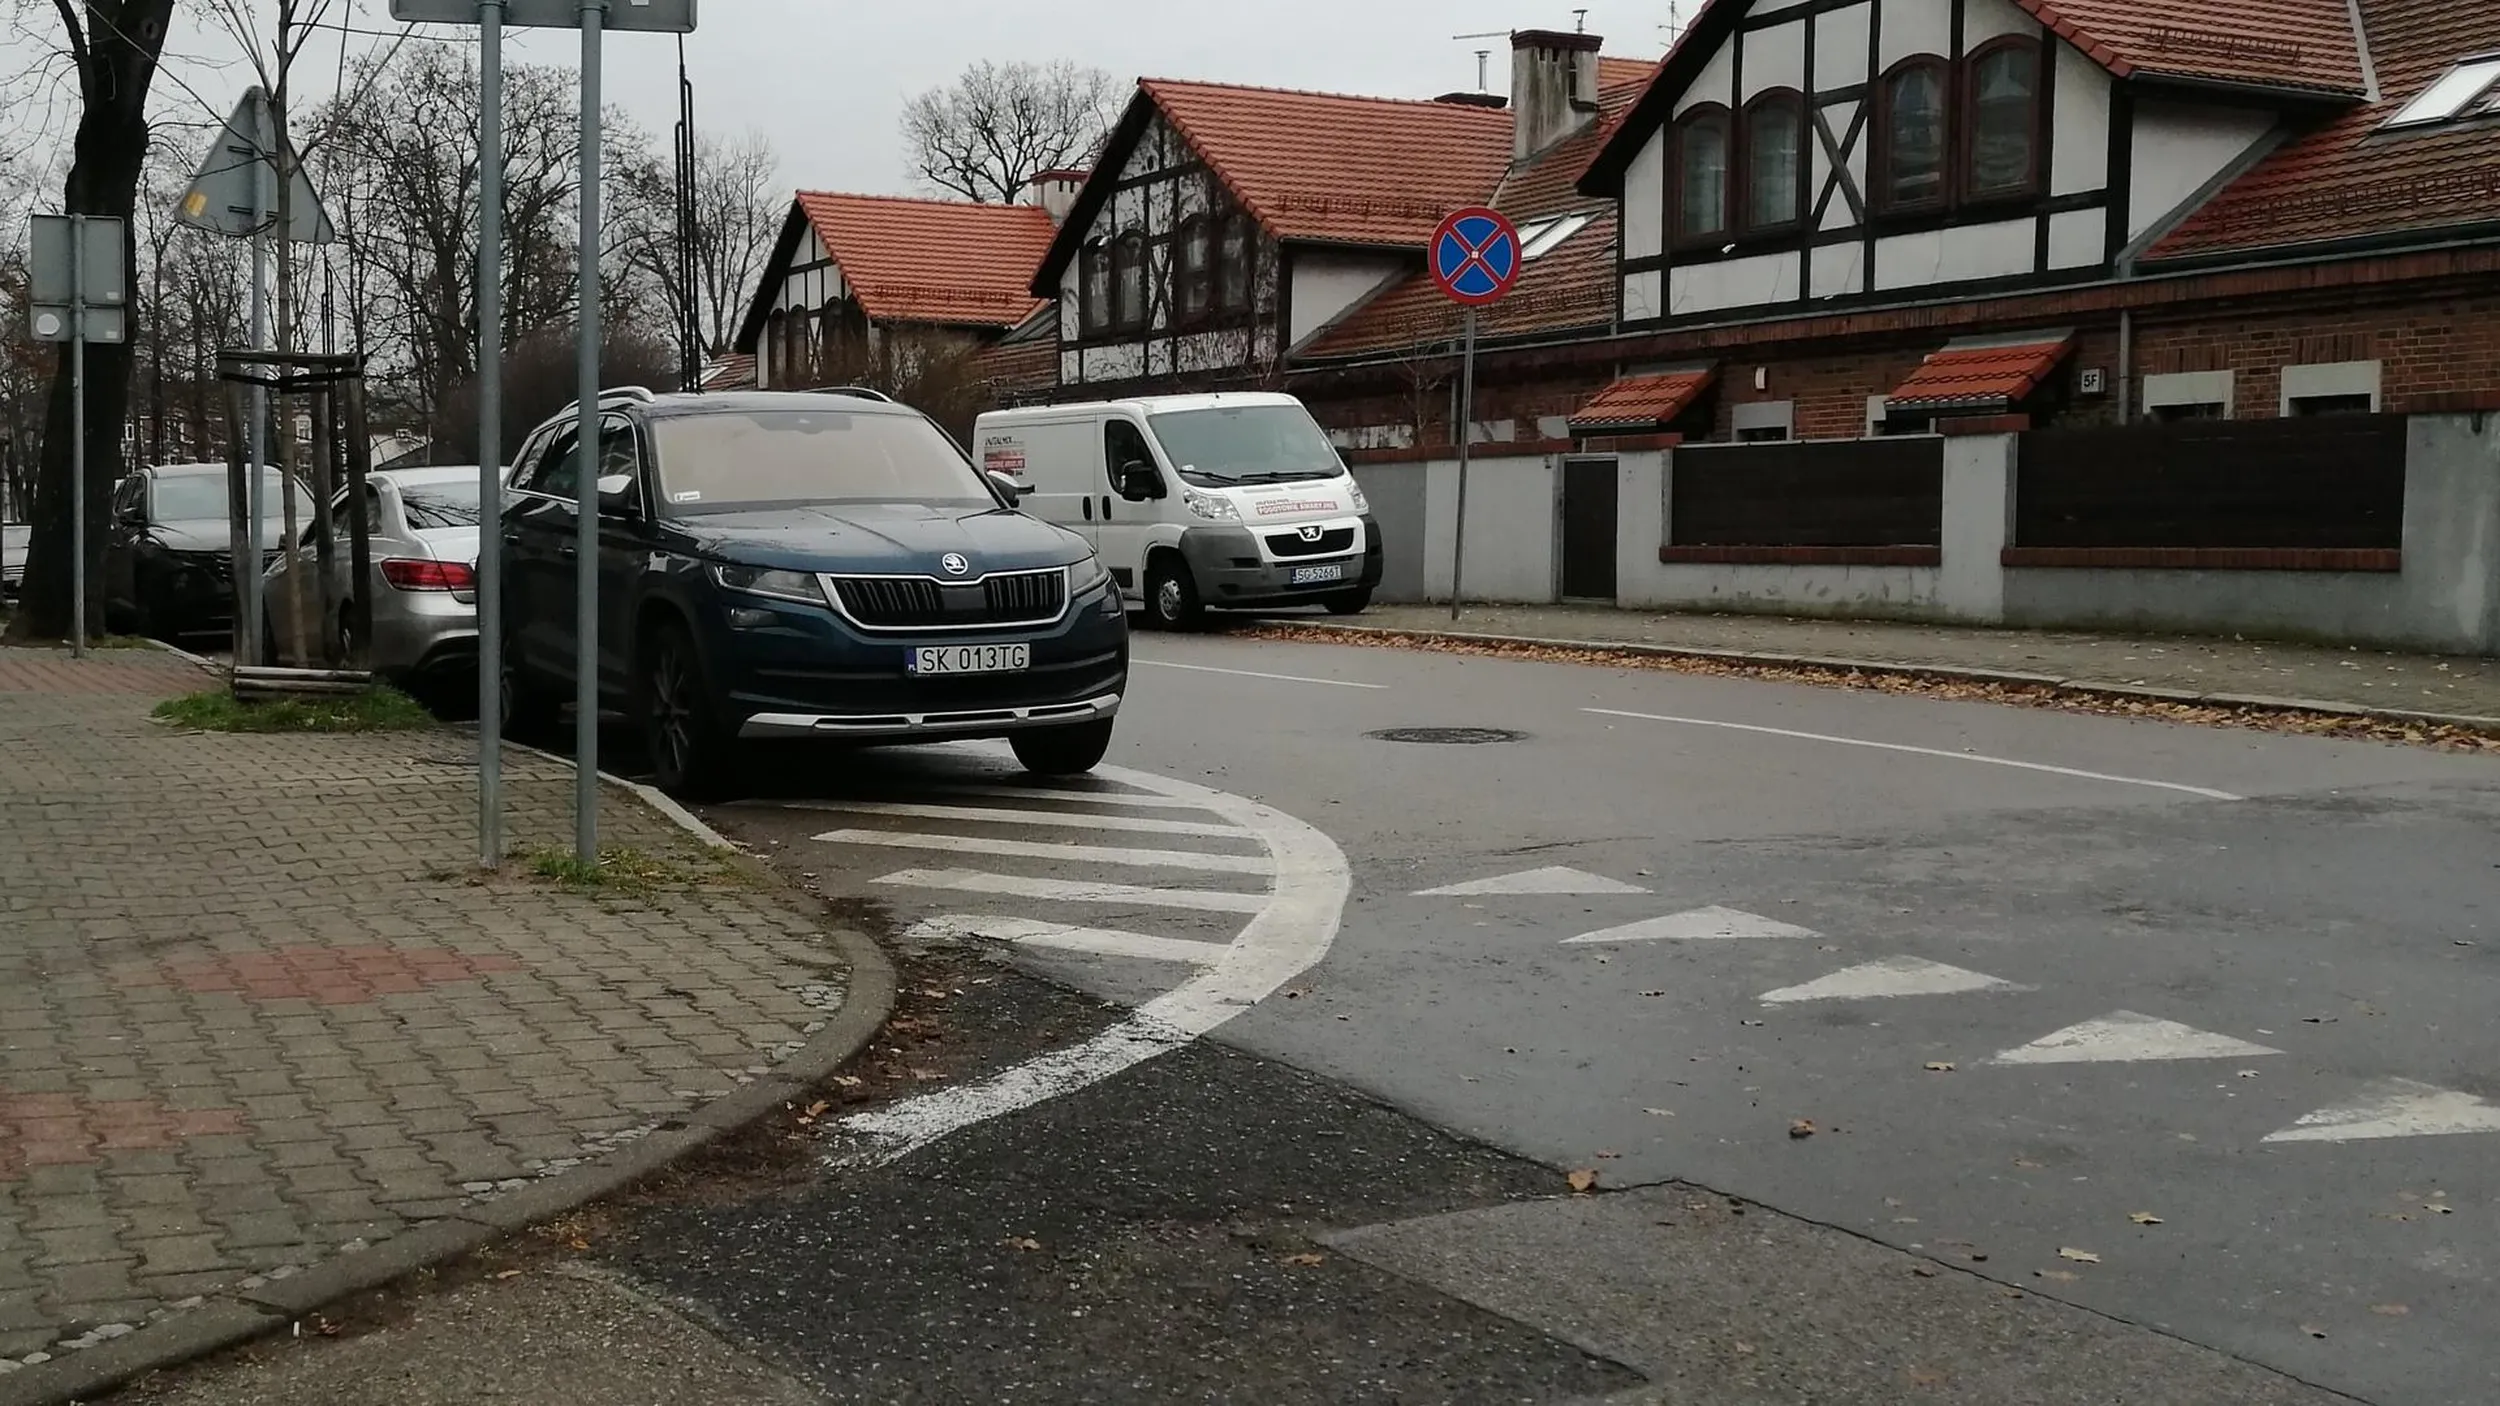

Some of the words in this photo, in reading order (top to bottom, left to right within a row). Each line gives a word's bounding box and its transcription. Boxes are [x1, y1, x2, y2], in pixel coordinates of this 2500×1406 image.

[2083, 374, 2097, 387] 5F
[1297, 569, 1311, 581] SG
[922, 648, 950, 672] SK
[959, 645, 1025, 670] 013TG
